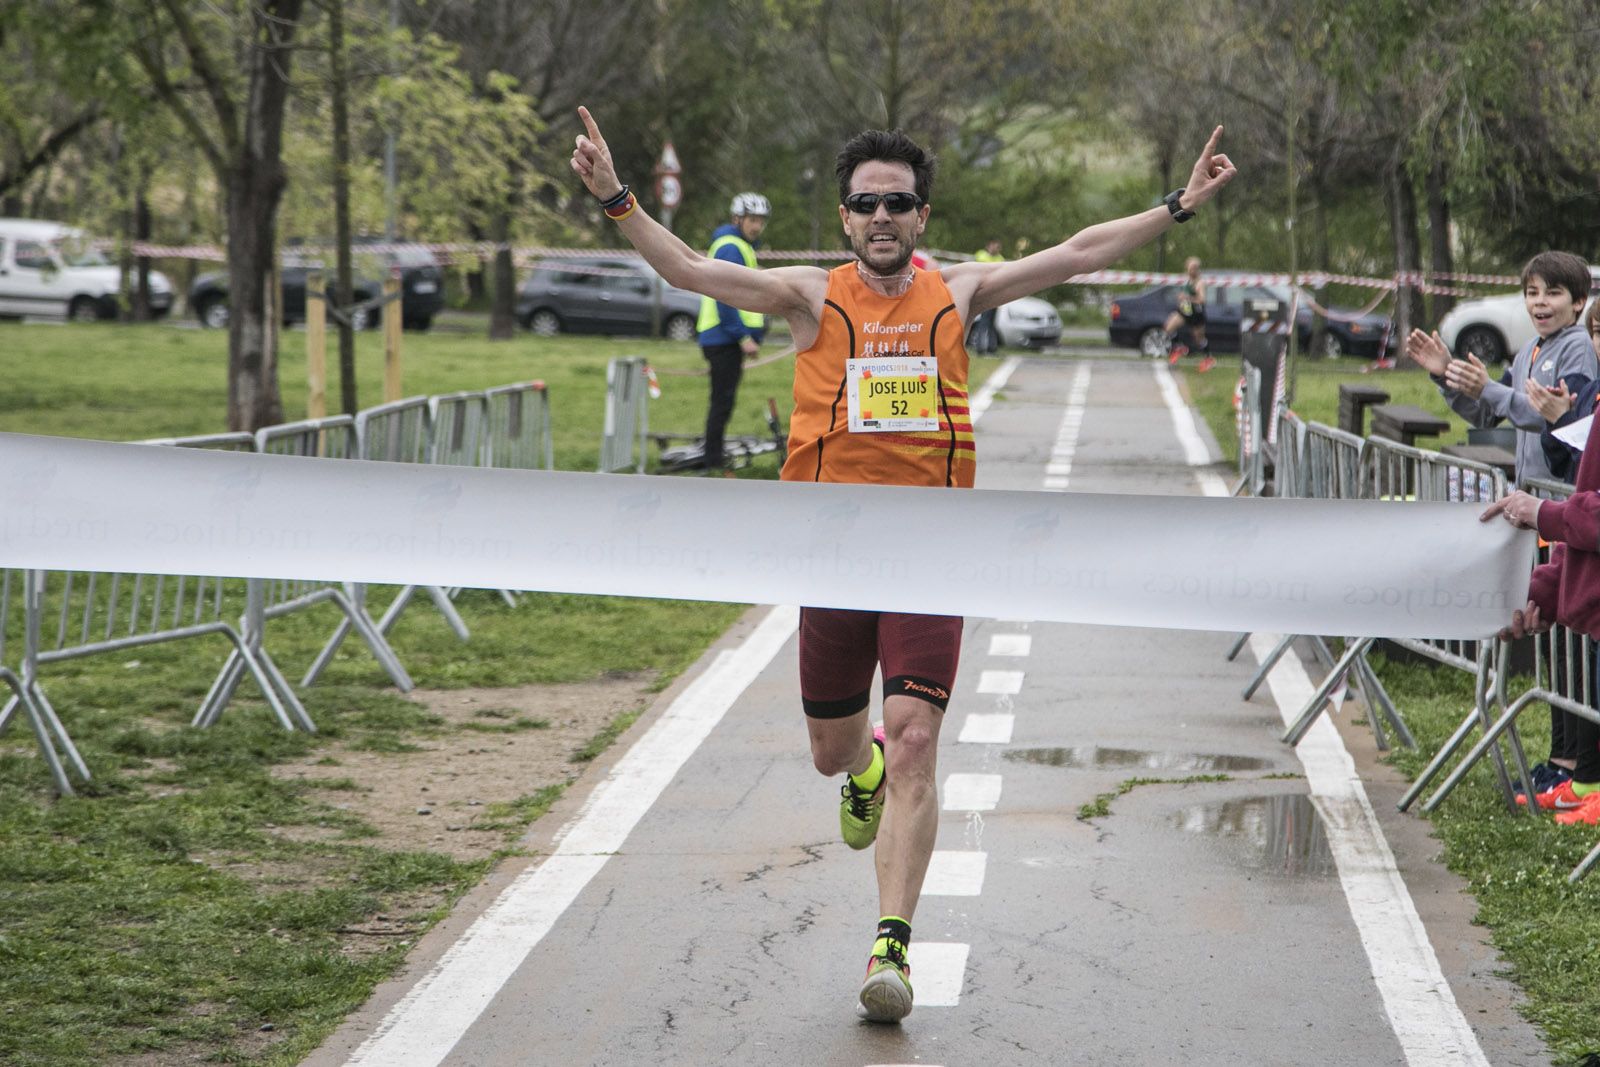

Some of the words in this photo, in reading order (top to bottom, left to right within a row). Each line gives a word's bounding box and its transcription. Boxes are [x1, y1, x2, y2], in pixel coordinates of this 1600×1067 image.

[863, 320, 924, 334] Kilometer
[869, 381, 897, 398] JOSE
[901, 381, 927, 395] LUIS
[891, 400, 908, 416] 52
